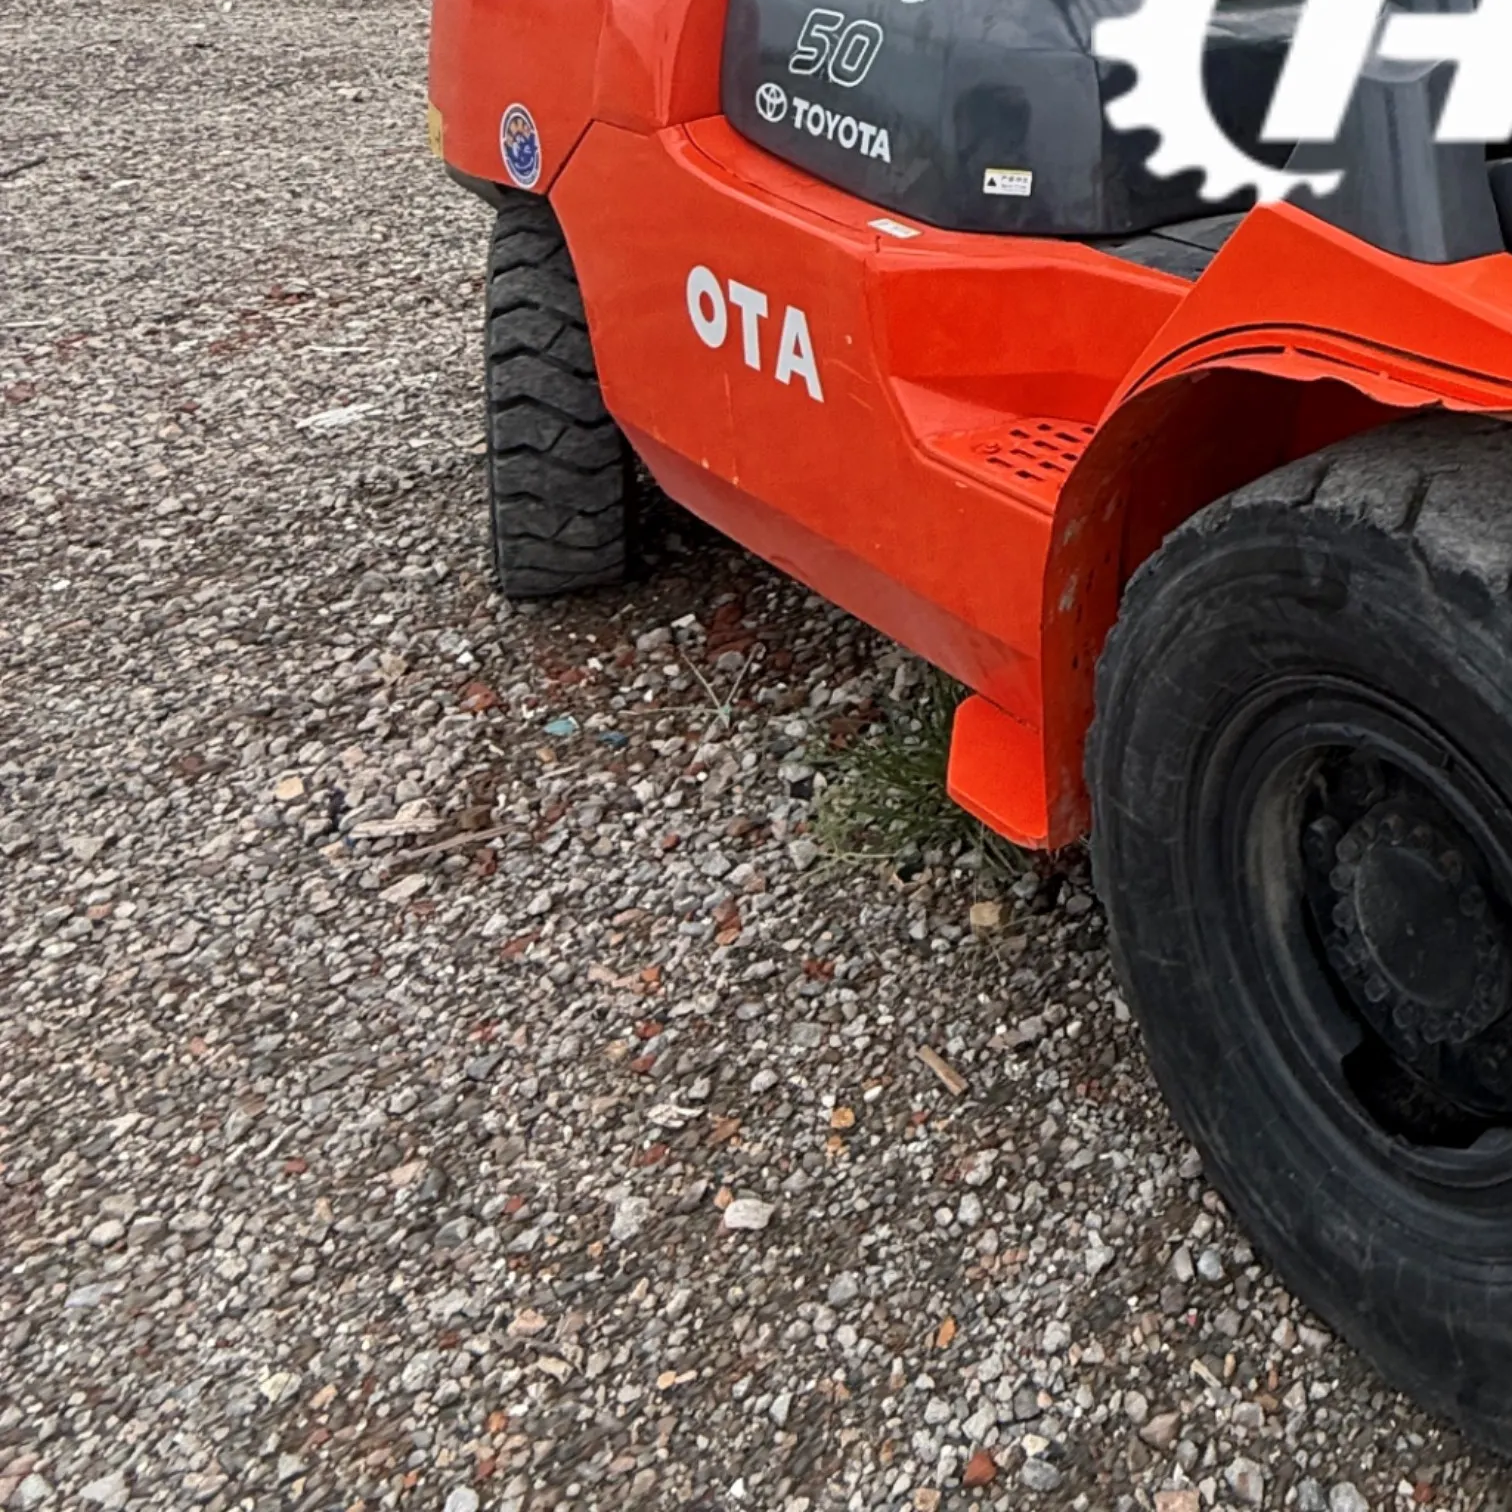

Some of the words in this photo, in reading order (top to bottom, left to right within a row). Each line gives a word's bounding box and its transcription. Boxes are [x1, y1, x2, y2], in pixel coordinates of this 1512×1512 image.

[788, 7, 884, 88] 50
[791, 96, 892, 164] TOYOTA
[686, 264, 825, 404] OTA
